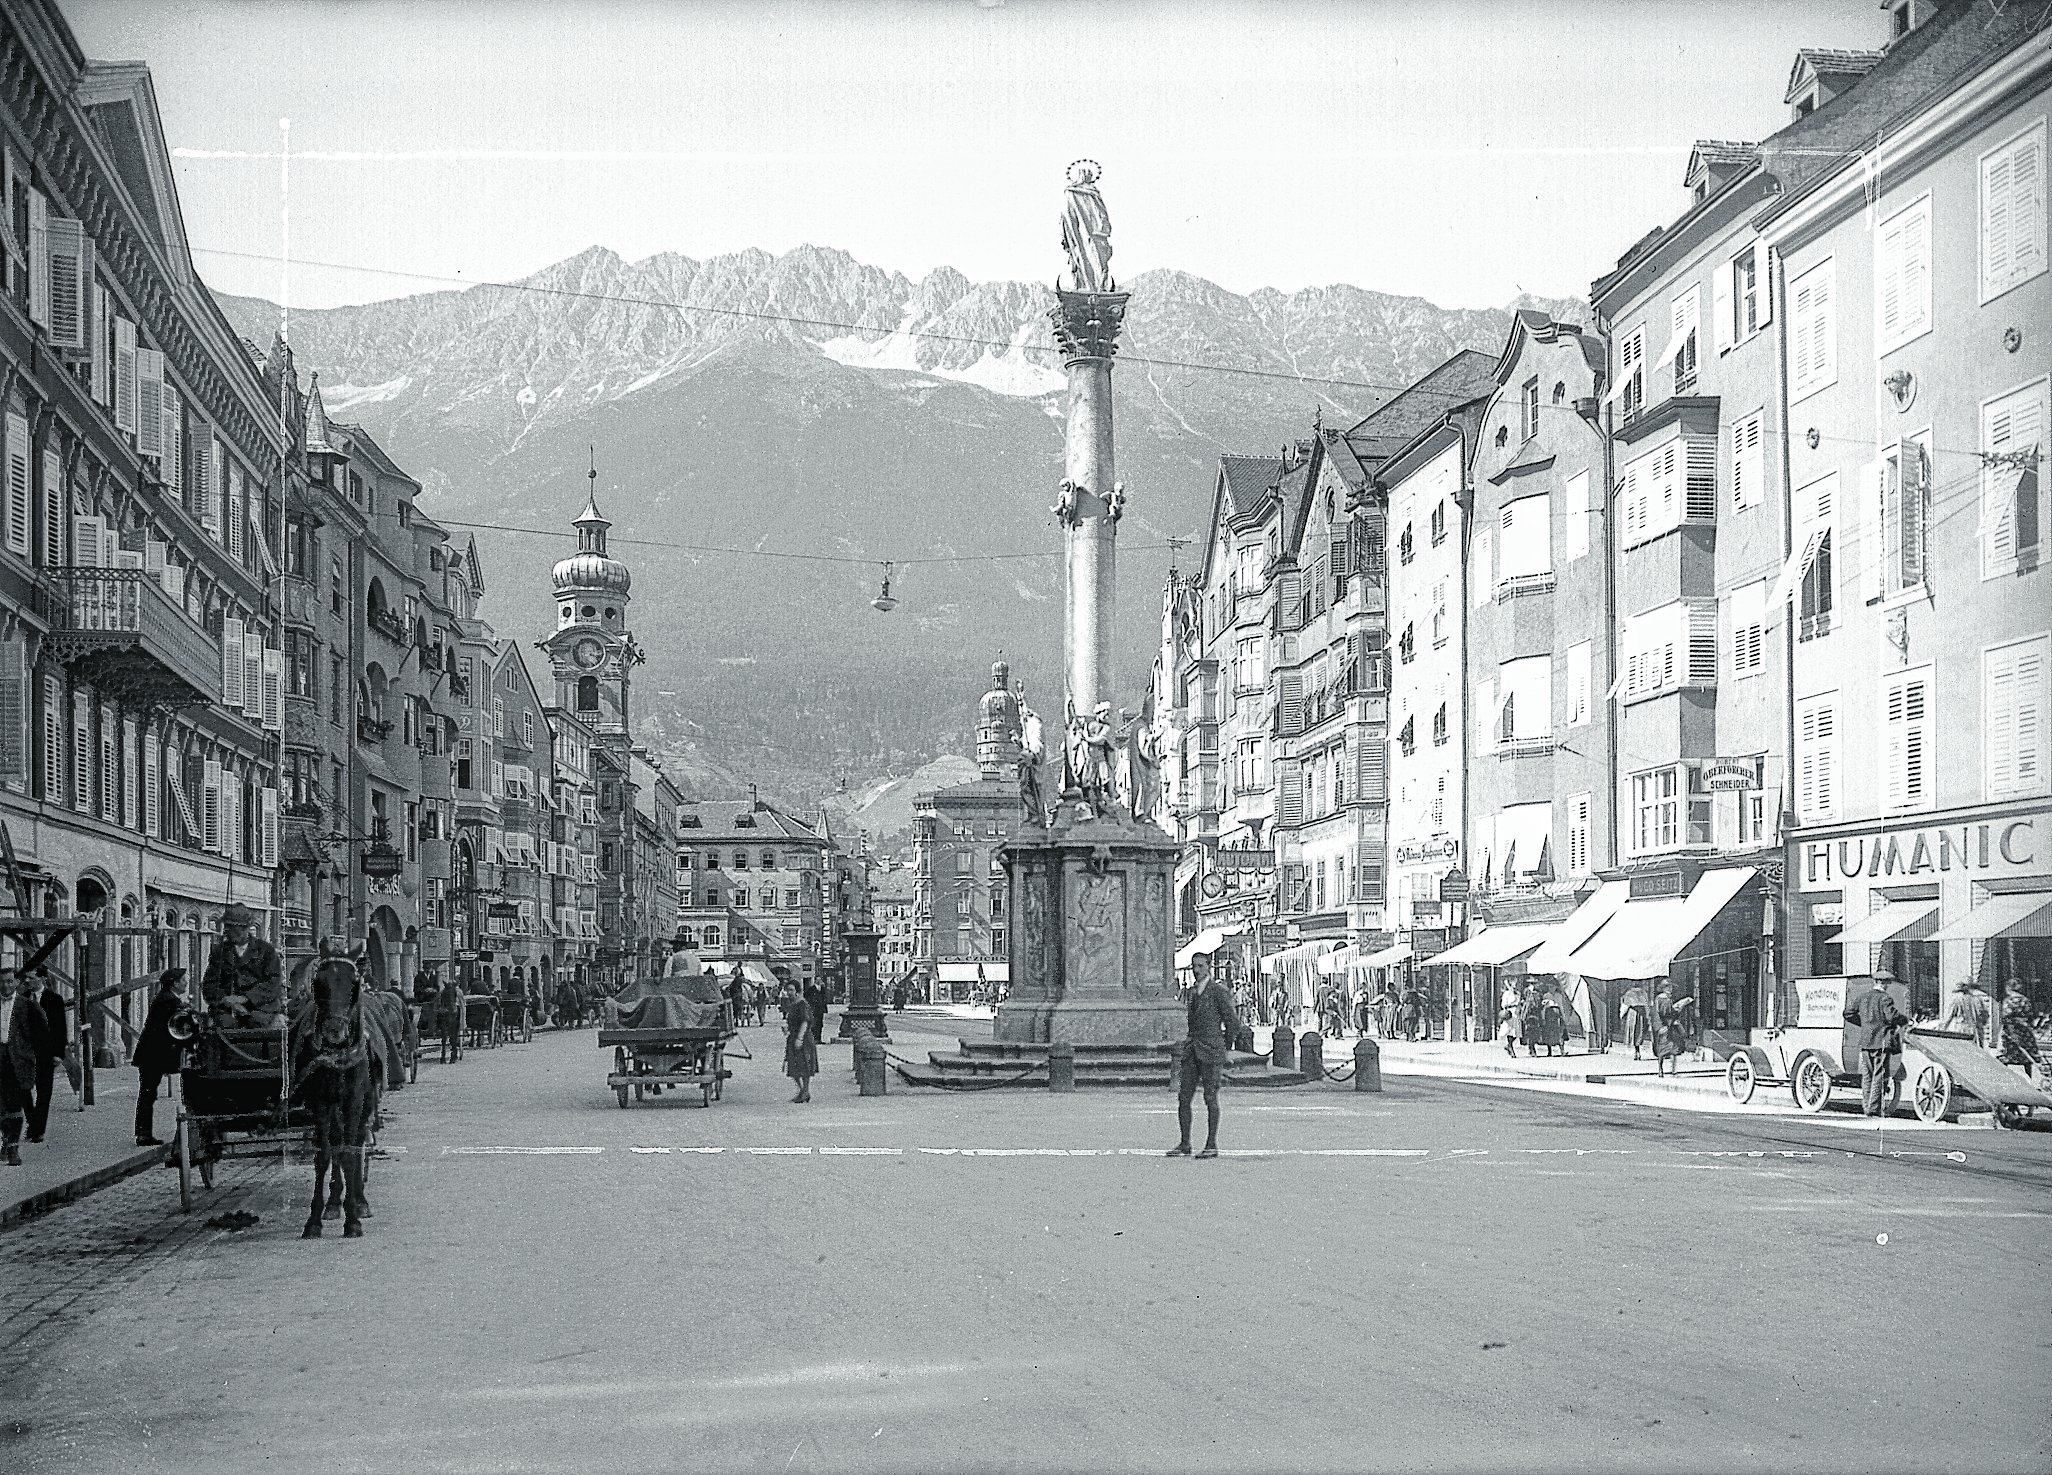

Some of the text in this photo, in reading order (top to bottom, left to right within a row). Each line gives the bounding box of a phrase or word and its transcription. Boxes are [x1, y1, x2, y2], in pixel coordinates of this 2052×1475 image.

[1710, 779, 1750, 789] SCHNEIDER
[1807, 819, 2034, 882] HUMANIC
[1657, 877, 1678, 891] SEITZ
